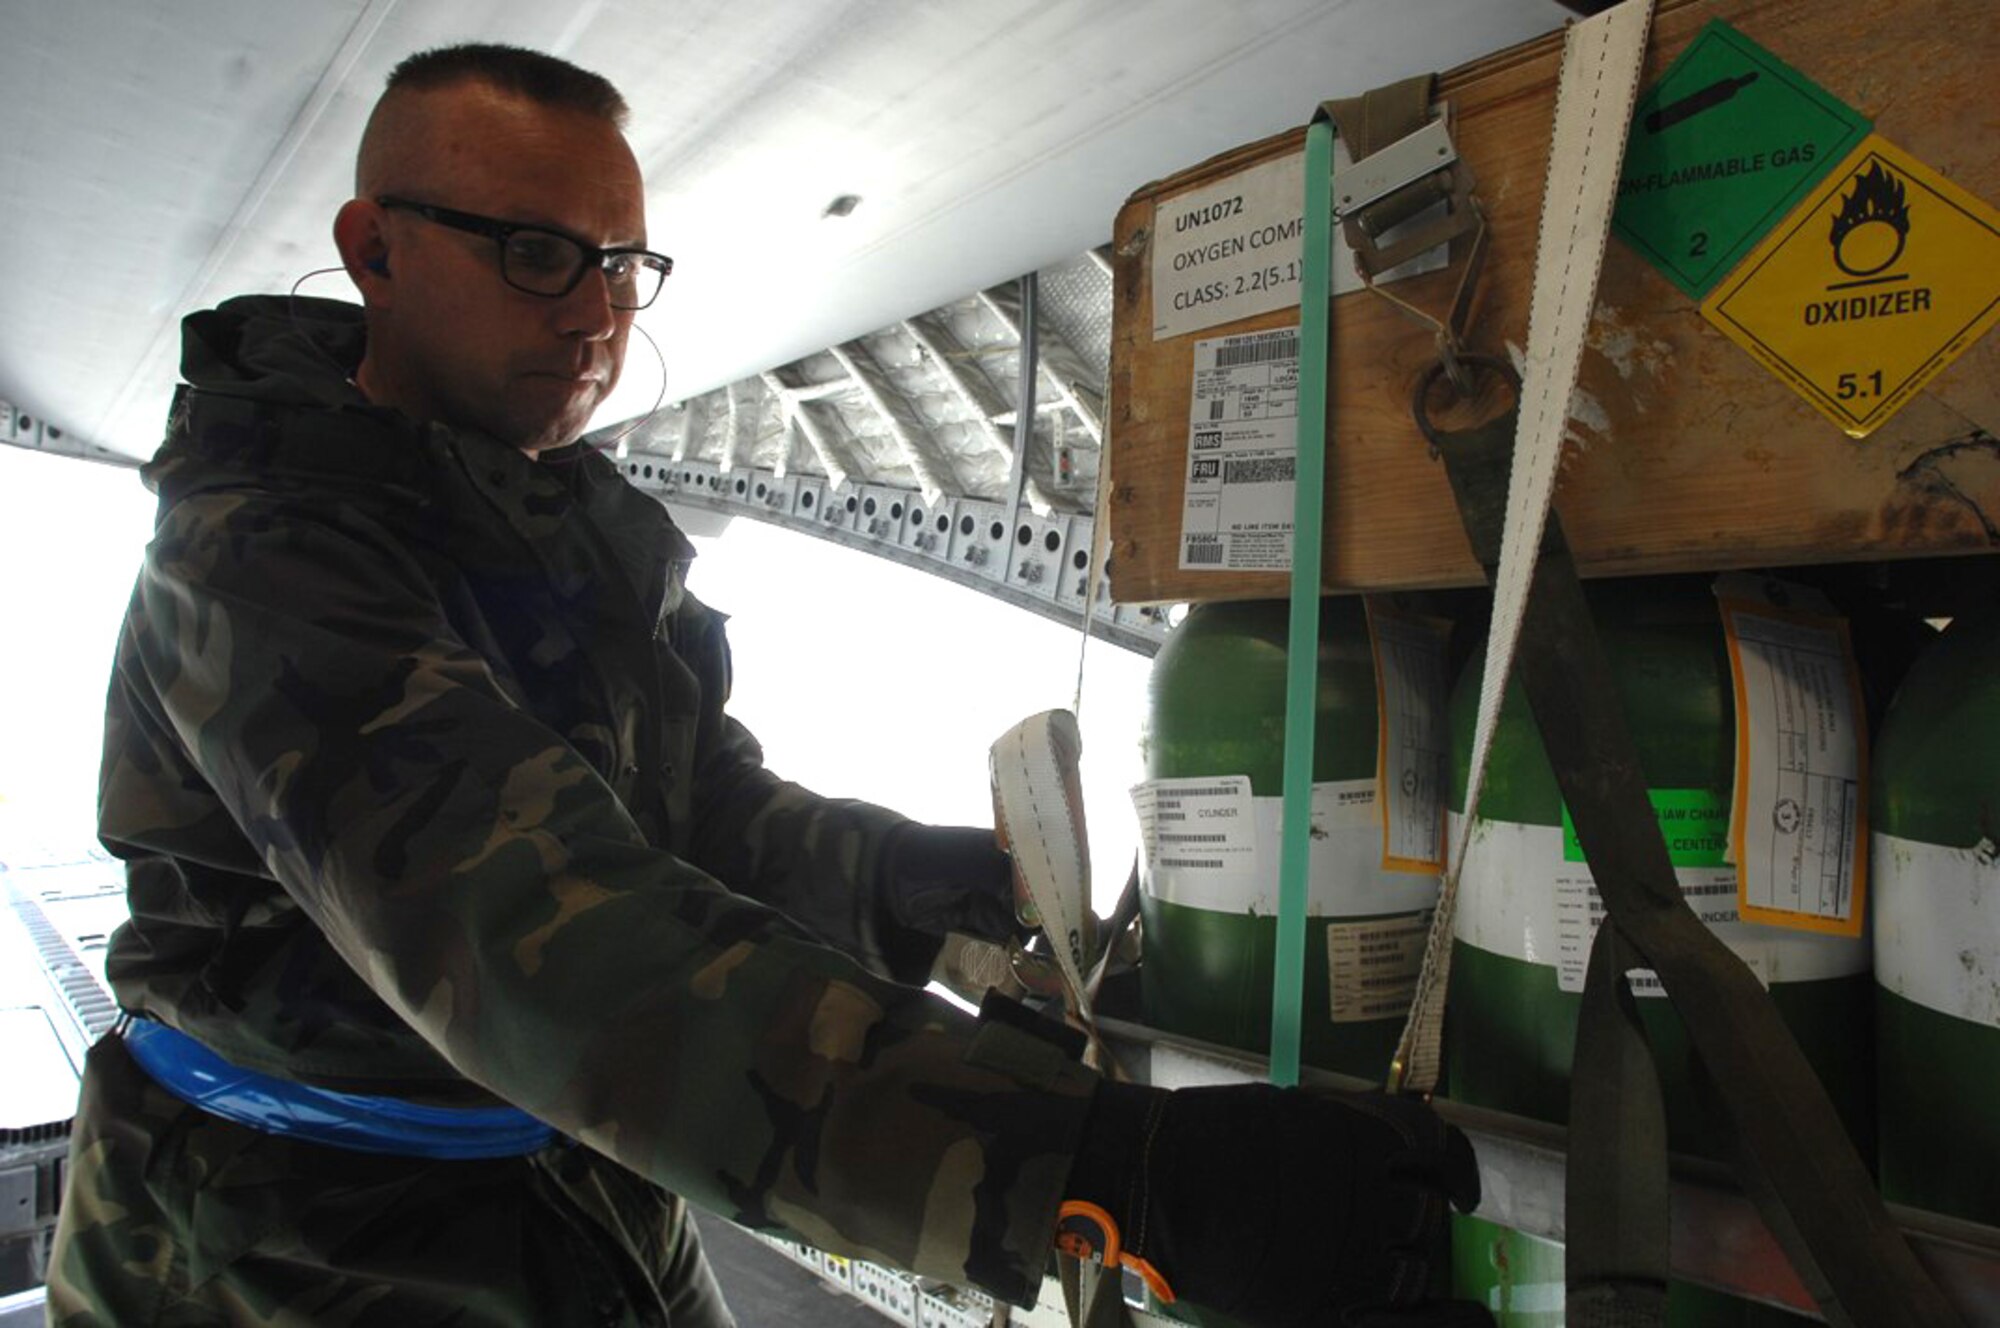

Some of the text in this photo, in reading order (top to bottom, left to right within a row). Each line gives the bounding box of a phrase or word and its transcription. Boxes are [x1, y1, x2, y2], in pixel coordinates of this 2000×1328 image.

[1616, 143, 1816, 197] ON-FLAMMABLE GAS
[1175, 195, 1244, 233] UN1072
[1172, 233, 1244, 272] OXYGEN
[1689, 232, 1708, 258] 2
[1173, 257, 1304, 311] CLASS: 2.2(5.1)
[1804, 287, 1932, 327] OXIDIZER
[1836, 370, 1884, 401] 5.1
[1194, 432, 1221, 449] RMS
[1192, 460, 1217, 477] FRU
[1197, 807, 1238, 819] CYLINDER
[1702, 909, 1739, 923] INDER
